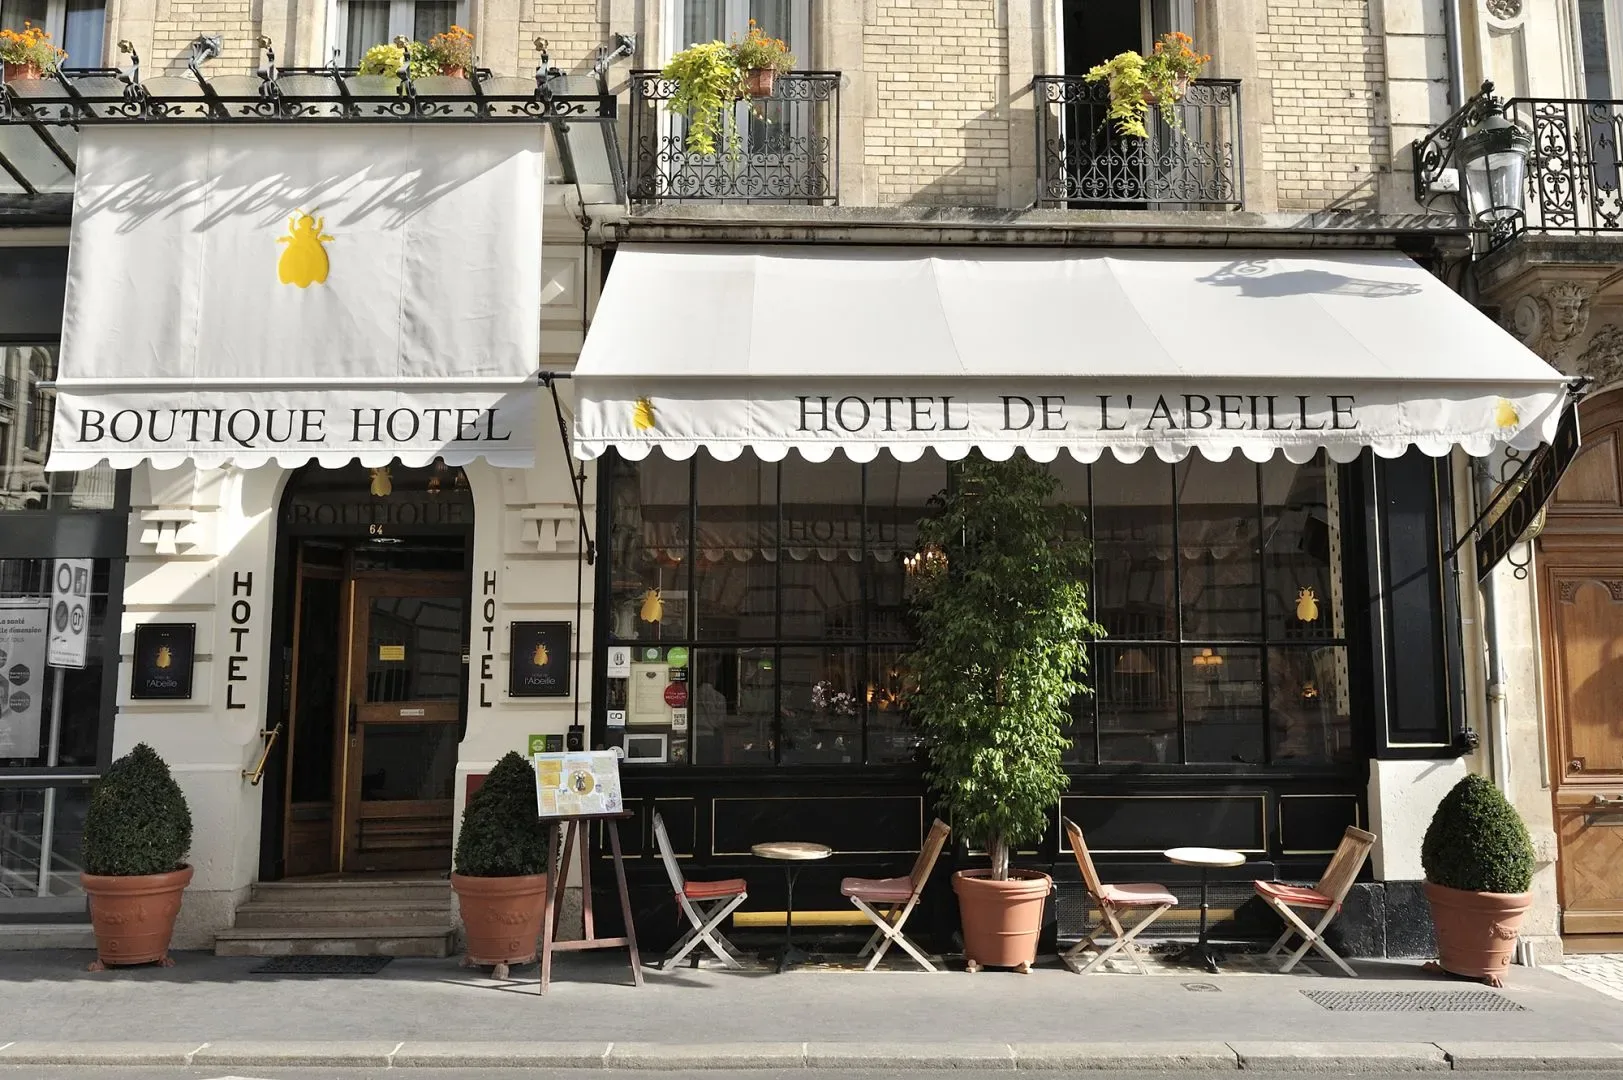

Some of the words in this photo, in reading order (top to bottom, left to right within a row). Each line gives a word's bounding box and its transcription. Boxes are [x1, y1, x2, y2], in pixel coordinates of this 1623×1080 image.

[77, 409, 326, 448] BOUTIQUE
[351, 408, 512, 442] HOTEL
[795, 396, 969, 432] HOTEL
[998, 396, 1067, 431] DE
[1096, 394, 1358, 431] L'ABEILLE
[369, 523, 383, 536] 64
[226, 571, 252, 710] HOTEL
[480, 570, 496, 708] HOTEL
